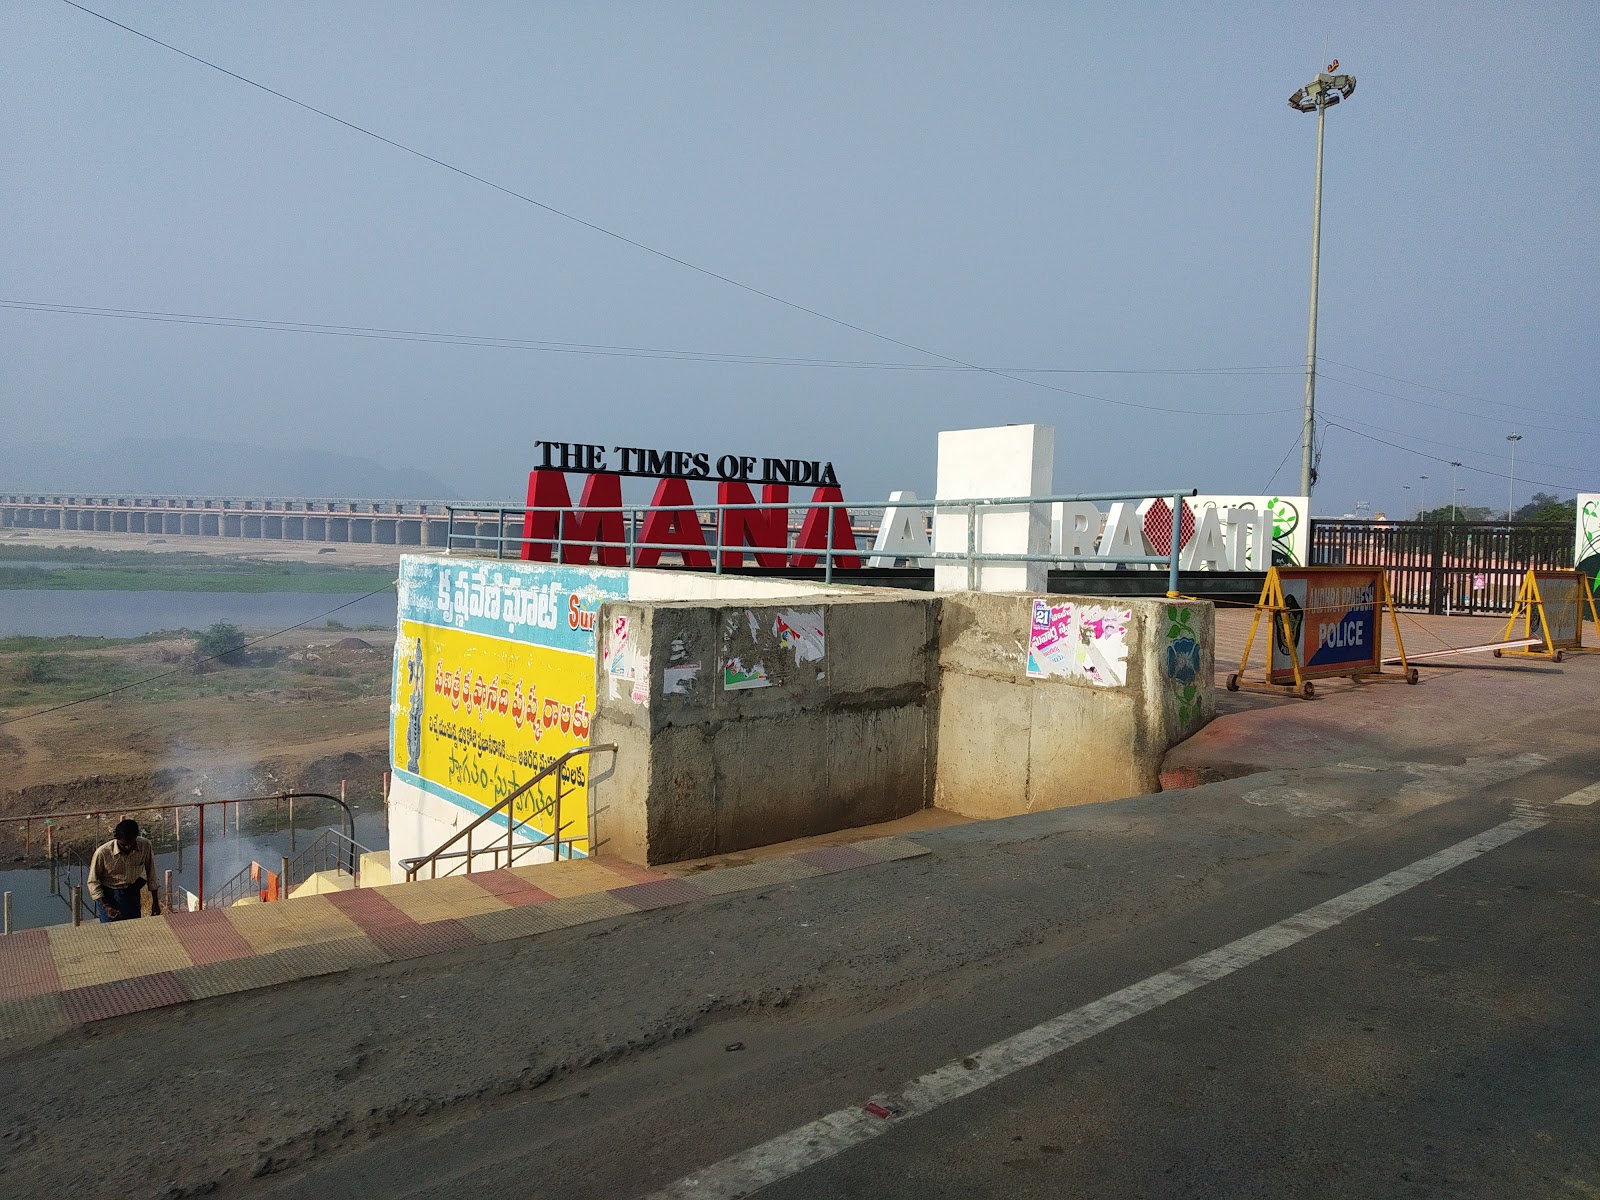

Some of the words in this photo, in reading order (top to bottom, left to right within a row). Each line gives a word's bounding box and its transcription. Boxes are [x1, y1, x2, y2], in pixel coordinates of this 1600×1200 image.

[534, 440, 607, 471] THE
[614, 446, 710, 478] TIMES
[717, 454, 756, 480] OF
[762, 458, 840, 485] INDIA
[521, 470, 862, 568] MANA
[1036, 610, 1049, 625] 21
[1308, 587, 1341, 614] ANDHRA
[1342, 586, 1375, 613] PRADESH
[1319, 620, 1364, 649] POLICE
[434, 658, 462, 712] పవిత్ర
